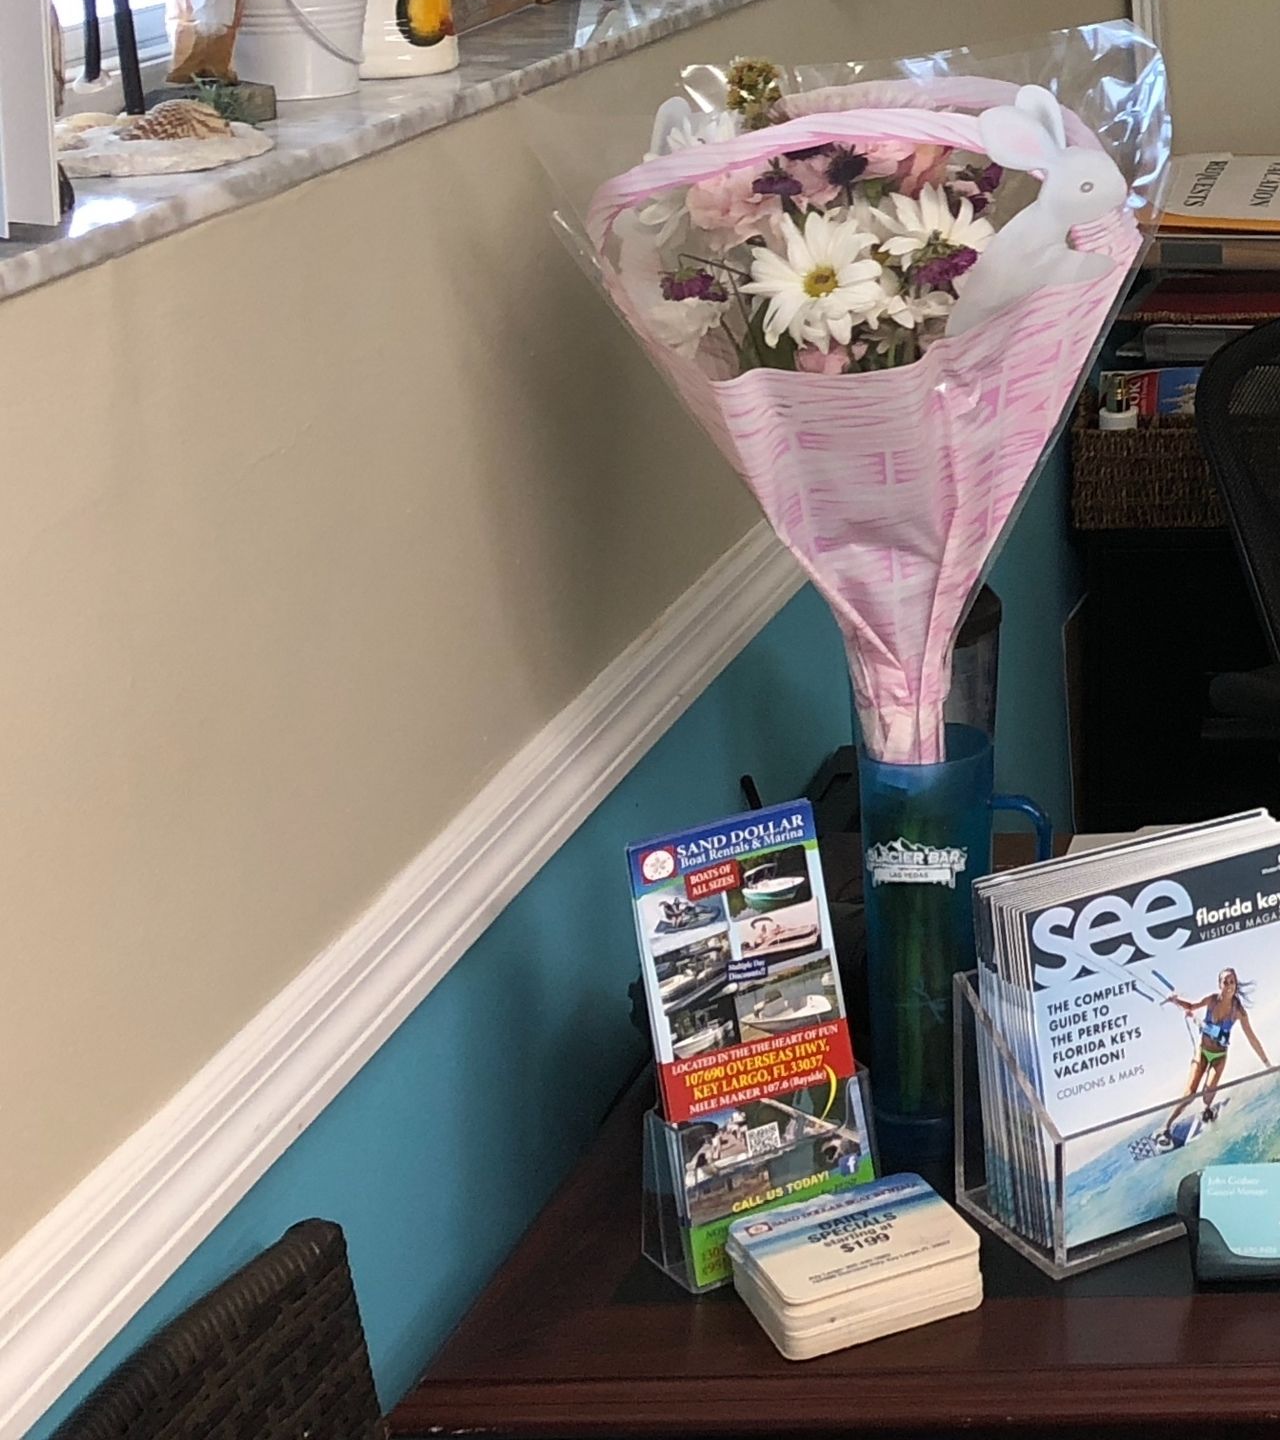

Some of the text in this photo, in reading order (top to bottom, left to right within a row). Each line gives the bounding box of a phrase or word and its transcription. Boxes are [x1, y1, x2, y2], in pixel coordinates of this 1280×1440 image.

[1183, 160, 1229, 207] REQUESTS
[676, 813, 805, 858] SAND DOLLAR
[681, 828, 804, 869] Boat Rentals & Marina
[690, 863, 732, 884] BOATS OF
[928, 851, 961, 865] BAR
[692, 875, 735, 896] ALL SIZES!
[1032, 879, 1194, 988] see
[1196, 897, 1253, 927] florida
[1200, 922, 1241, 941] VISITOR
[1047, 980, 1137, 1016] THE COMPLETE
[1049, 1004, 1110, 1032] GUIDE TO
[1050, 1014, 1128, 1048] THE PERFECT
[672, 1023, 838, 1076] LOCATED IN THE THE HEART OF FUN
[1053, 1026, 1142, 1064] FLORIDA KEYS
[685, 1037, 830, 1088] 107690 OVERSEAS HWY,
[693, 1054, 823, 1101] KEY LARGO, FL 33037
[1054, 1048, 1126, 1080] VACATION!
[1056, 1064, 1145, 1101] COUPONS & MAPS
[689, 1098, 718, 1115] MILE
[720, 1086, 760, 1108] MAKER
[732, 1170, 830, 1214] CALL US TODAY!
[807, 1212, 898, 1244] SPECIALS
[817, 1210, 870, 1230] DAILY
[824, 1222, 893, 1248] starting at
[839, 1232, 891, 1254] $199
